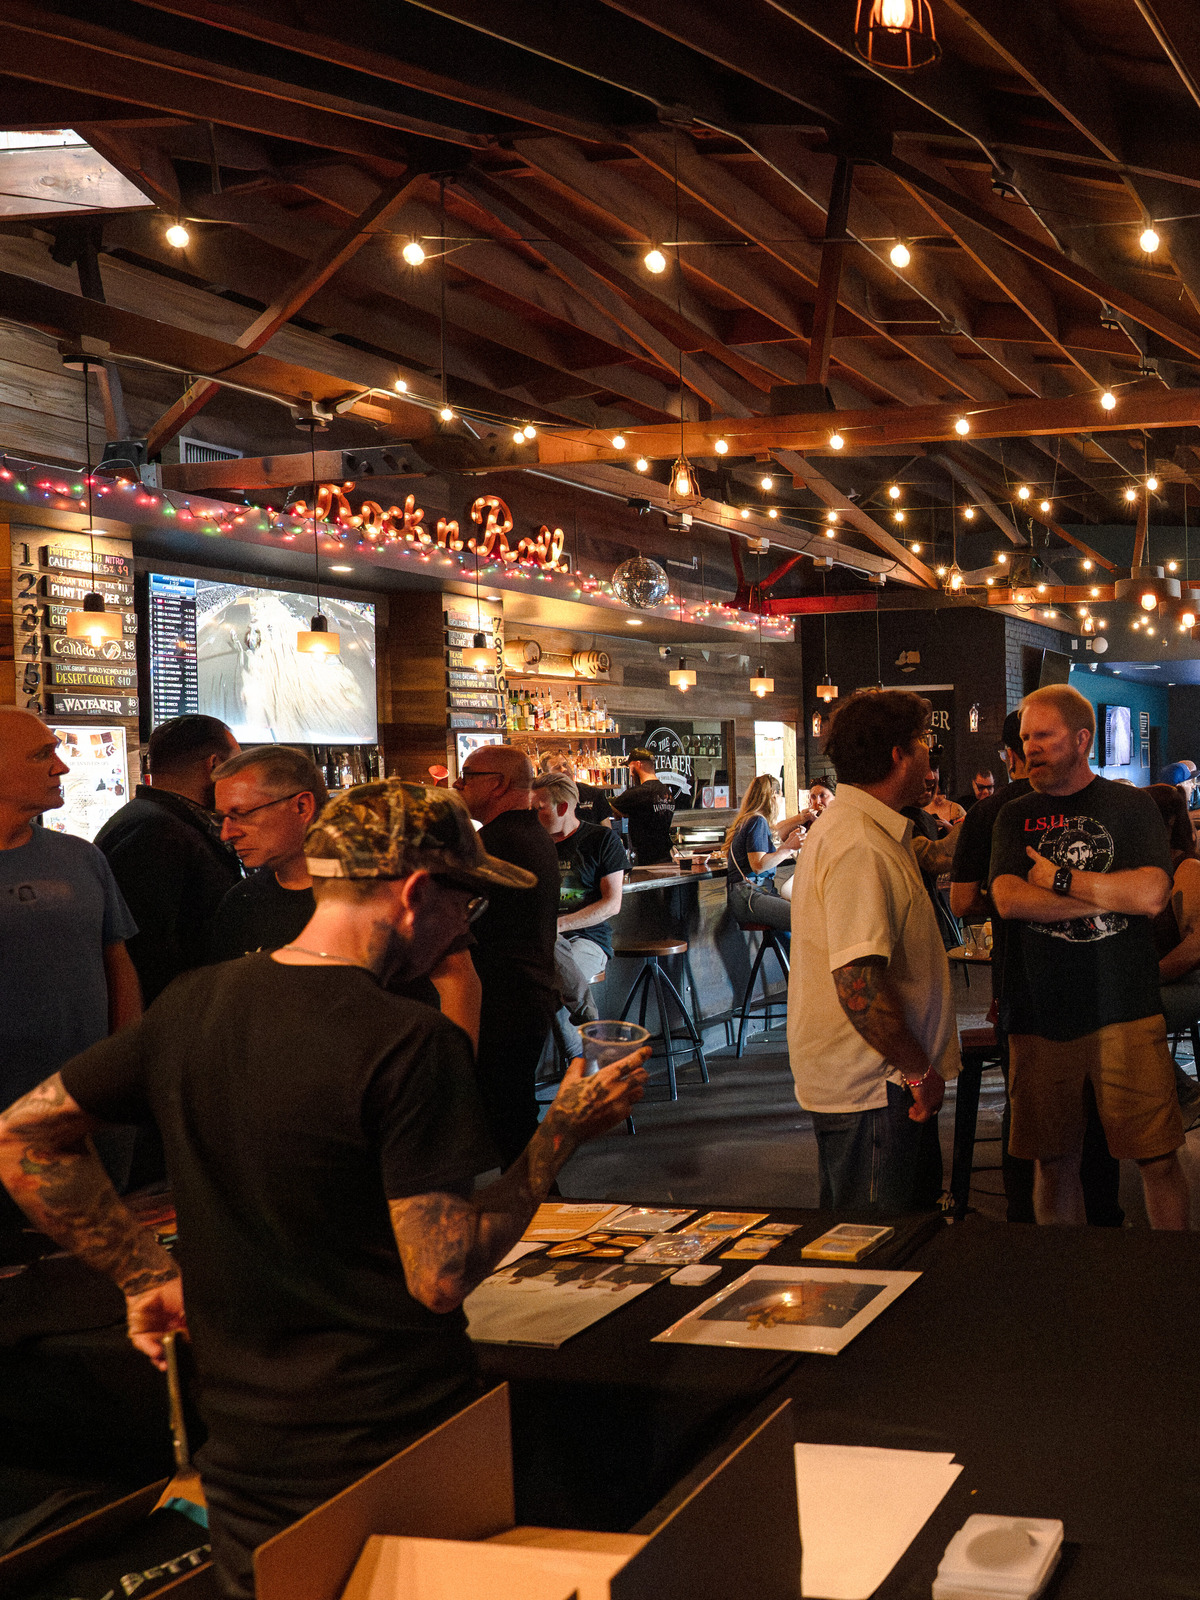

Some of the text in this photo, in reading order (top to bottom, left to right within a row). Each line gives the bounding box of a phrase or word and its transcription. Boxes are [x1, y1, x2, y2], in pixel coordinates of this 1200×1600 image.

[292, 479, 432, 544] Rock
[467, 494, 569, 574] Roll
[19, 542, 34, 566] 1
[49, 556, 66, 568] CALI
[105, 556, 124, 565] NITRO
[118, 565, 129, 576] $9
[18, 573, 38, 598] 2
[22, 604, 39, 632] 3
[125, 613, 136, 625] $9
[493, 617, 502, 634] 7
[22, 632, 41, 656] 4
[124, 640, 134, 650] $8
[494, 637, 503, 655] 8
[22, 662, 40, 695] 5
[56, 672, 131, 686] DESERT COOLER $10
[62, 698, 123, 715] WAYFARER
[658, 736, 671, 752] THE
[653, 755, 692, 777] YFARER
